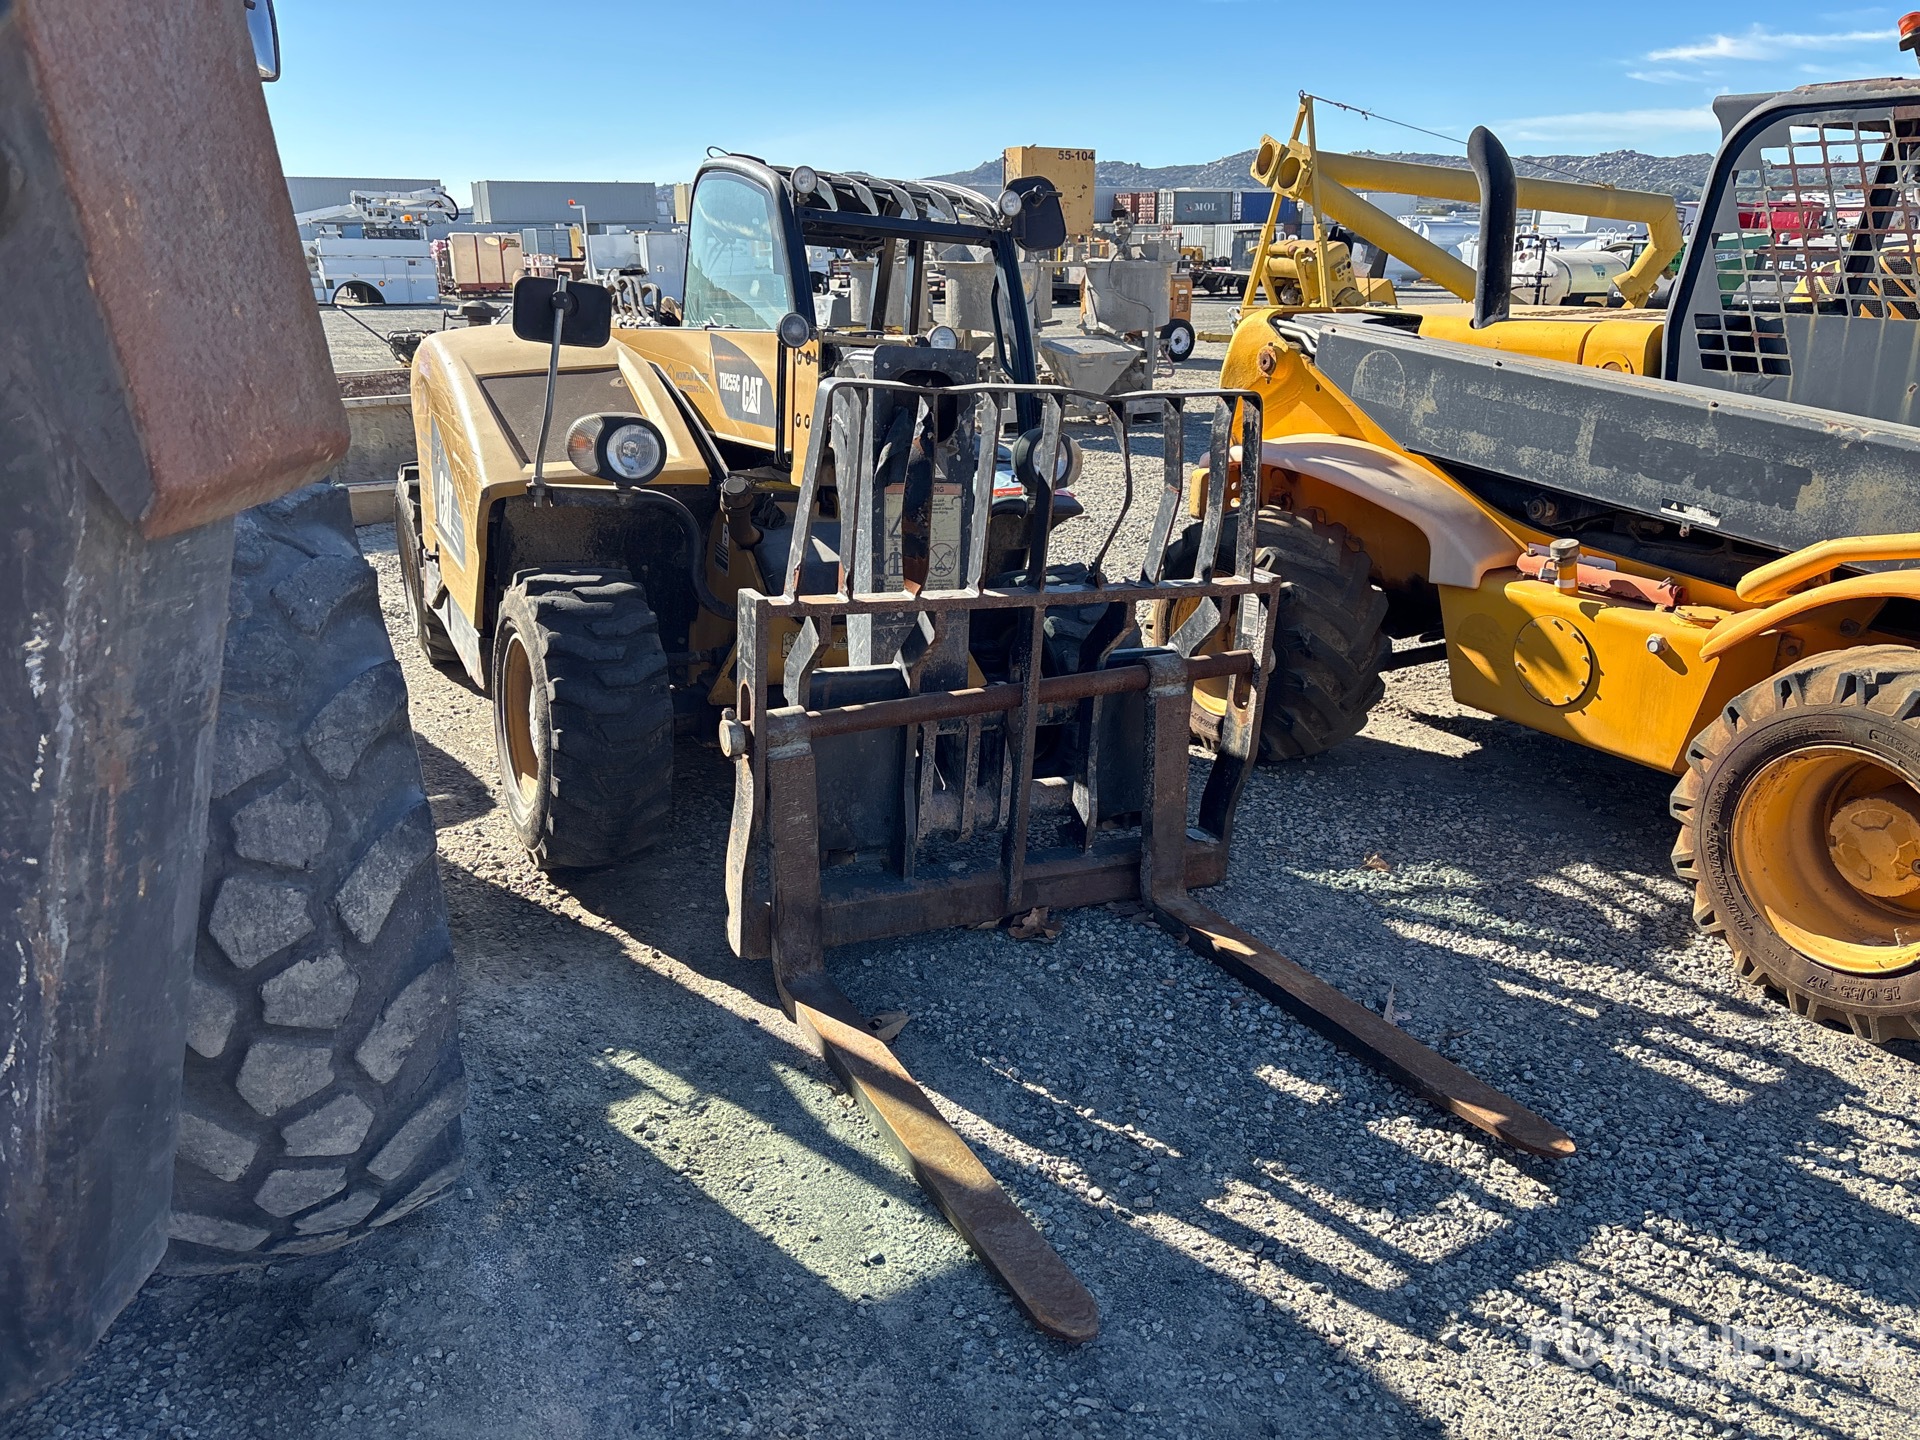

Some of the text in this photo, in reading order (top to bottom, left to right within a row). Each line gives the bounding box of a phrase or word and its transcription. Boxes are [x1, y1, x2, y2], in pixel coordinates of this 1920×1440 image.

[1058, 150, 1095, 161] 55-104
[1194, 202, 1217, 211] MOL
[1765, 260, 1798, 270] FUEL
[719, 372, 741, 393] TH255C
[741, 374, 763, 415] CAT
[438, 470, 453, 538] CAT
